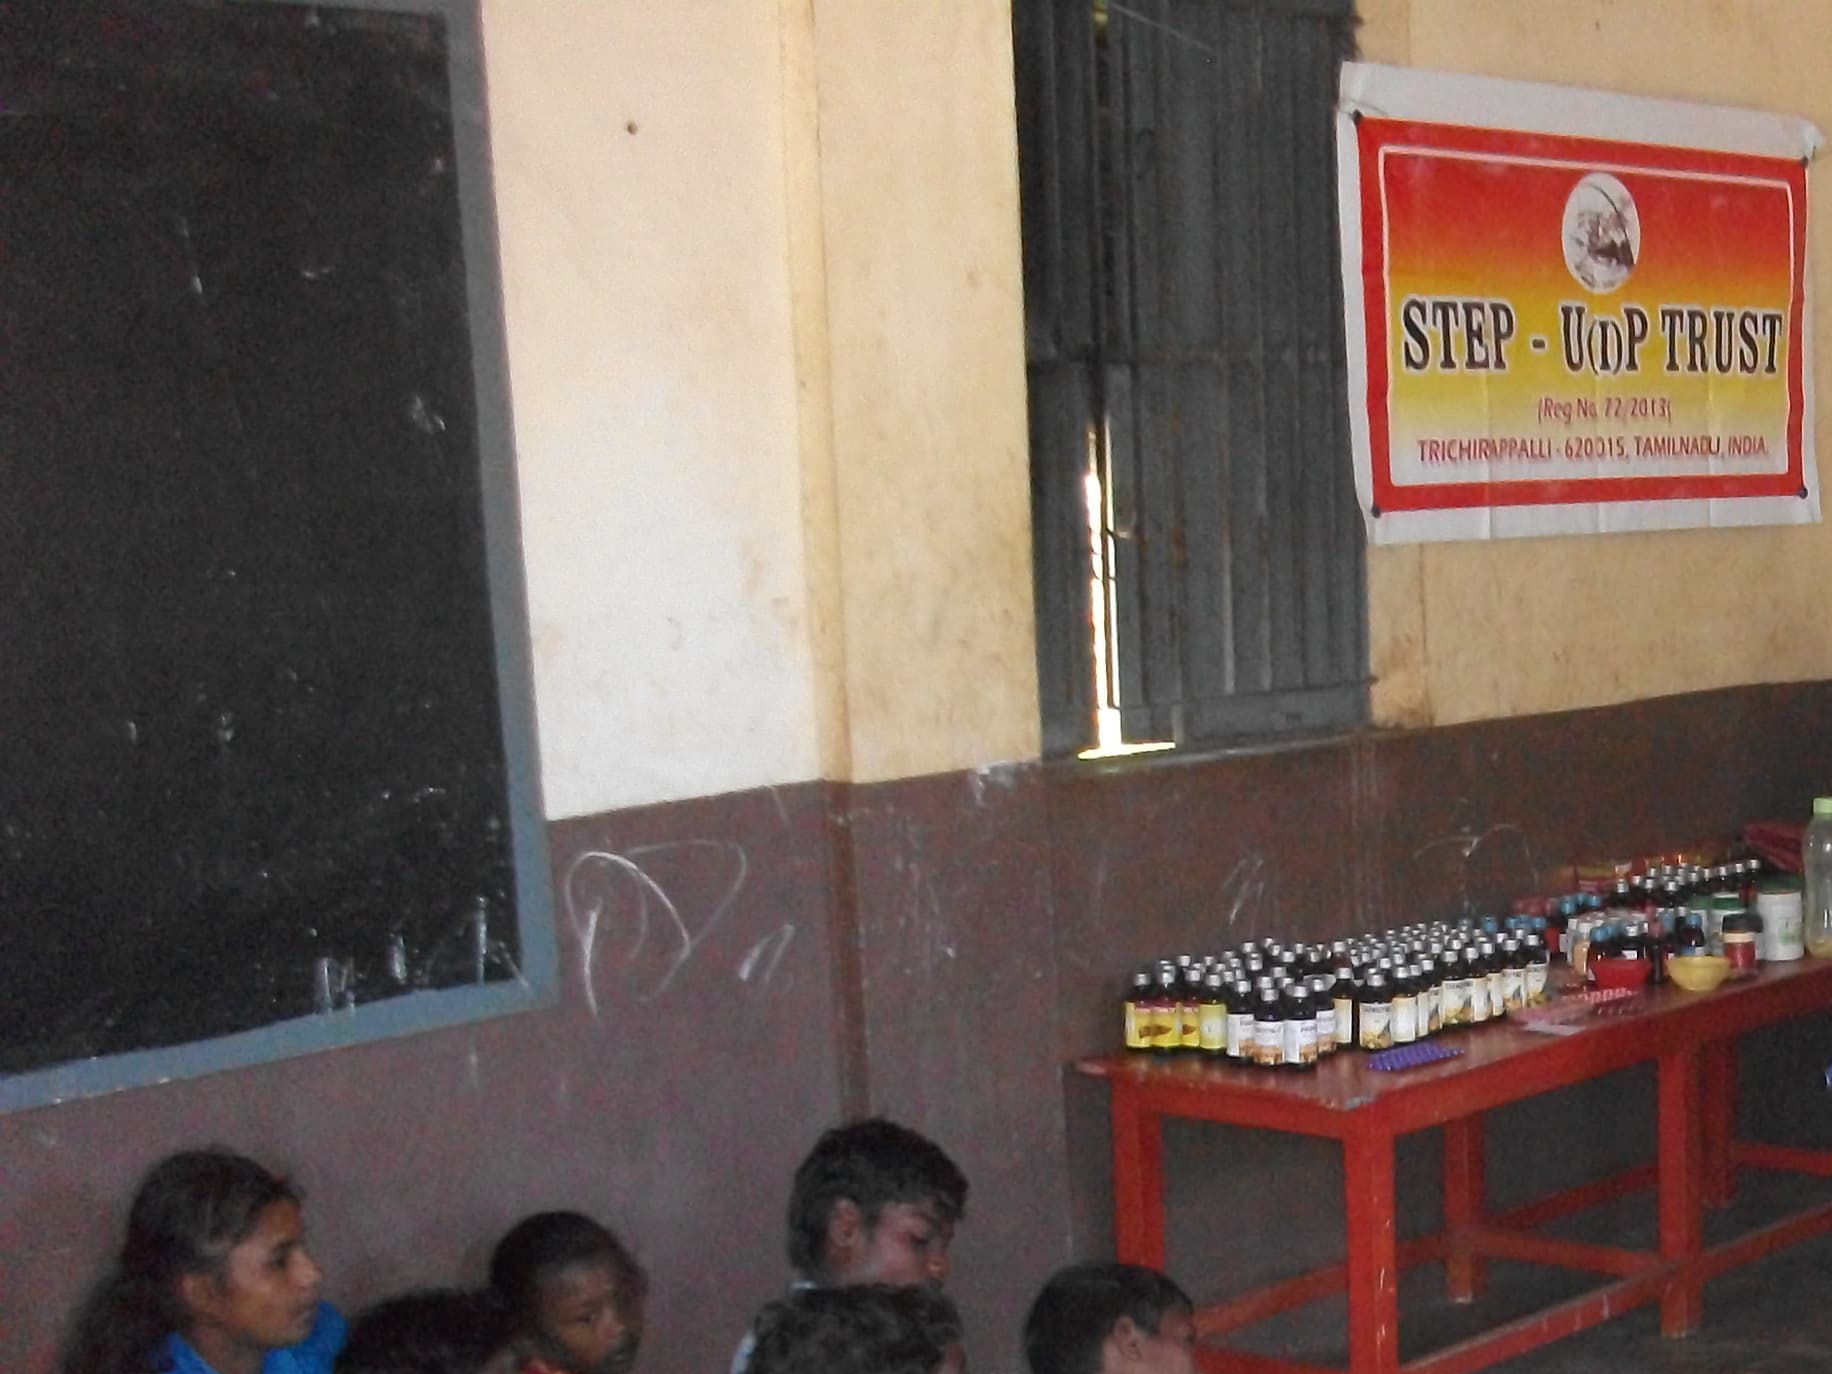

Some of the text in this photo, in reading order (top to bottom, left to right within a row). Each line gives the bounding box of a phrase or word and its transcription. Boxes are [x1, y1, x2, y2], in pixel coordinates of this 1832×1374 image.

[1402, 298, 1515, 371] STEP
[1560, 305, 1649, 376] U(I)P
[1660, 308, 1783, 374] TRUST
